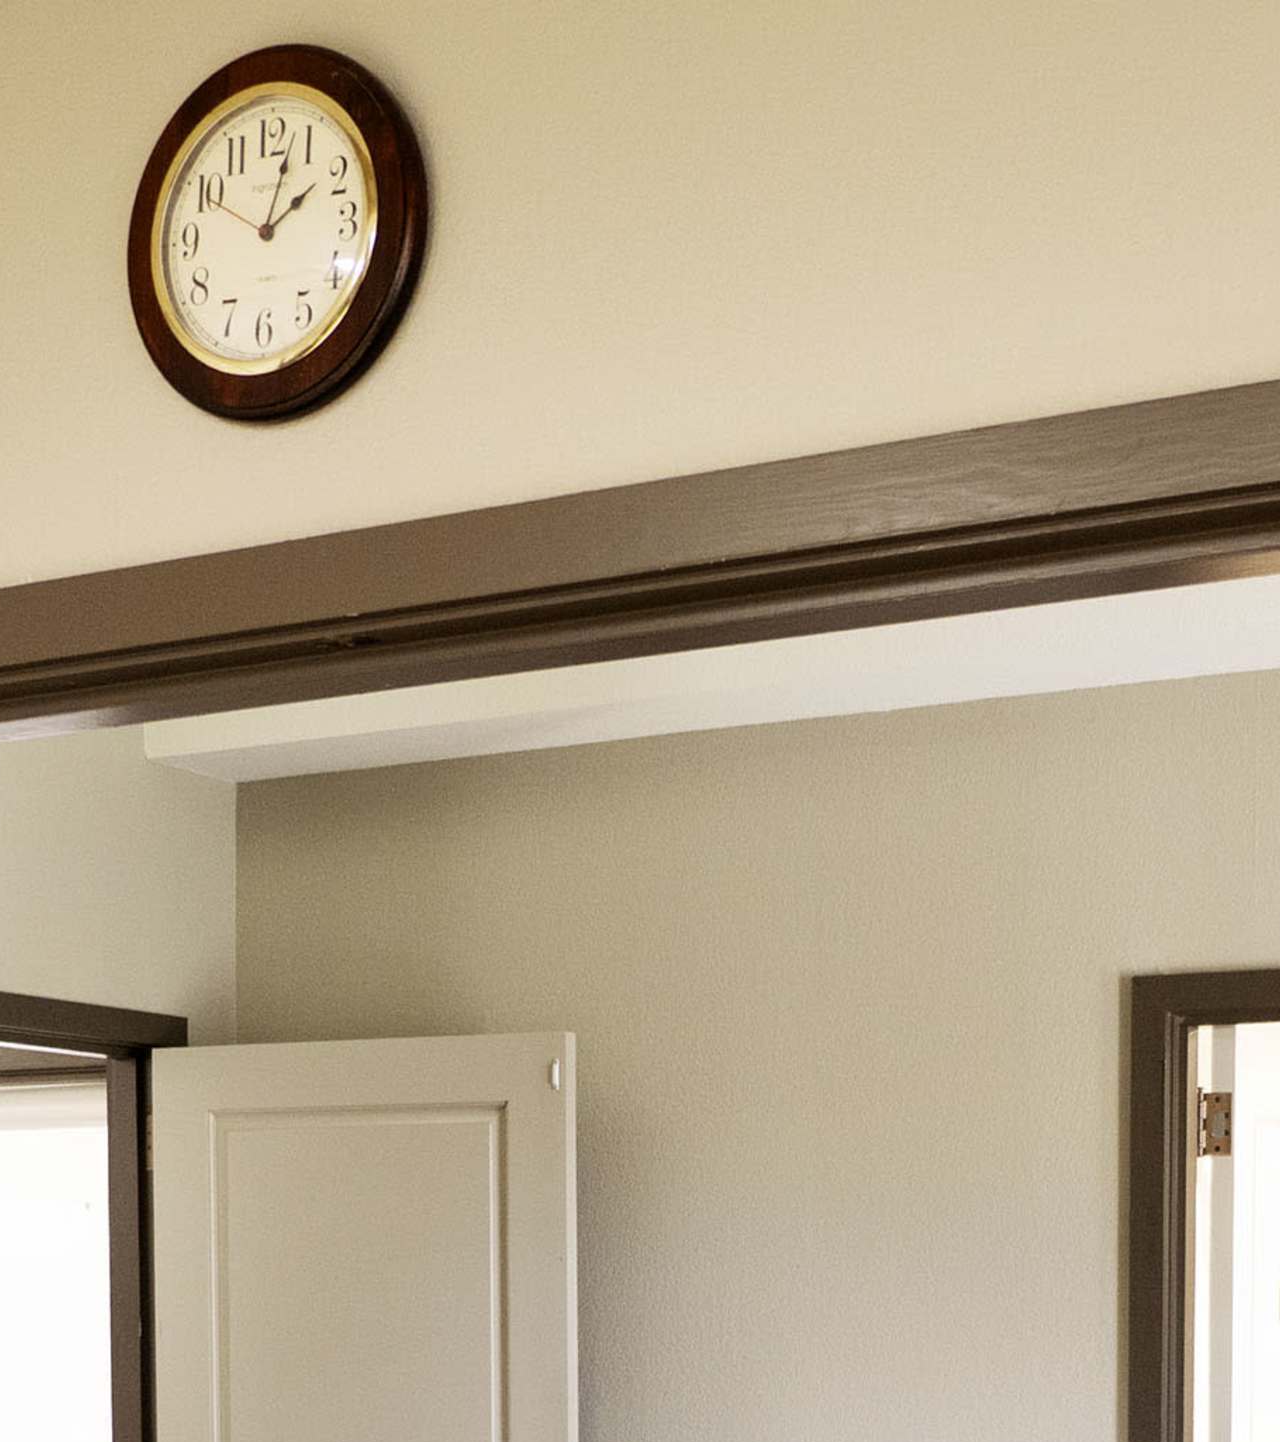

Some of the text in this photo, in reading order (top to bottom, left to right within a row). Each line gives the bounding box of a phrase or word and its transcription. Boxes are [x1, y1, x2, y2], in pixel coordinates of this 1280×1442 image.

[228, 136, 245, 176] 11
[261, 117, 286, 158] 12
[305, 125, 312, 164] 1
[198, 173, 224, 213] 10
[329, 156, 347, 195] 2
[339, 201, 357, 241] 3
[182, 222, 199, 261] 9
[190, 267, 209, 305] 8
[324, 251, 342, 289] 4
[222, 299, 238, 337] 7
[255, 309, 273, 348] 6
[295, 290, 312, 329] 5
